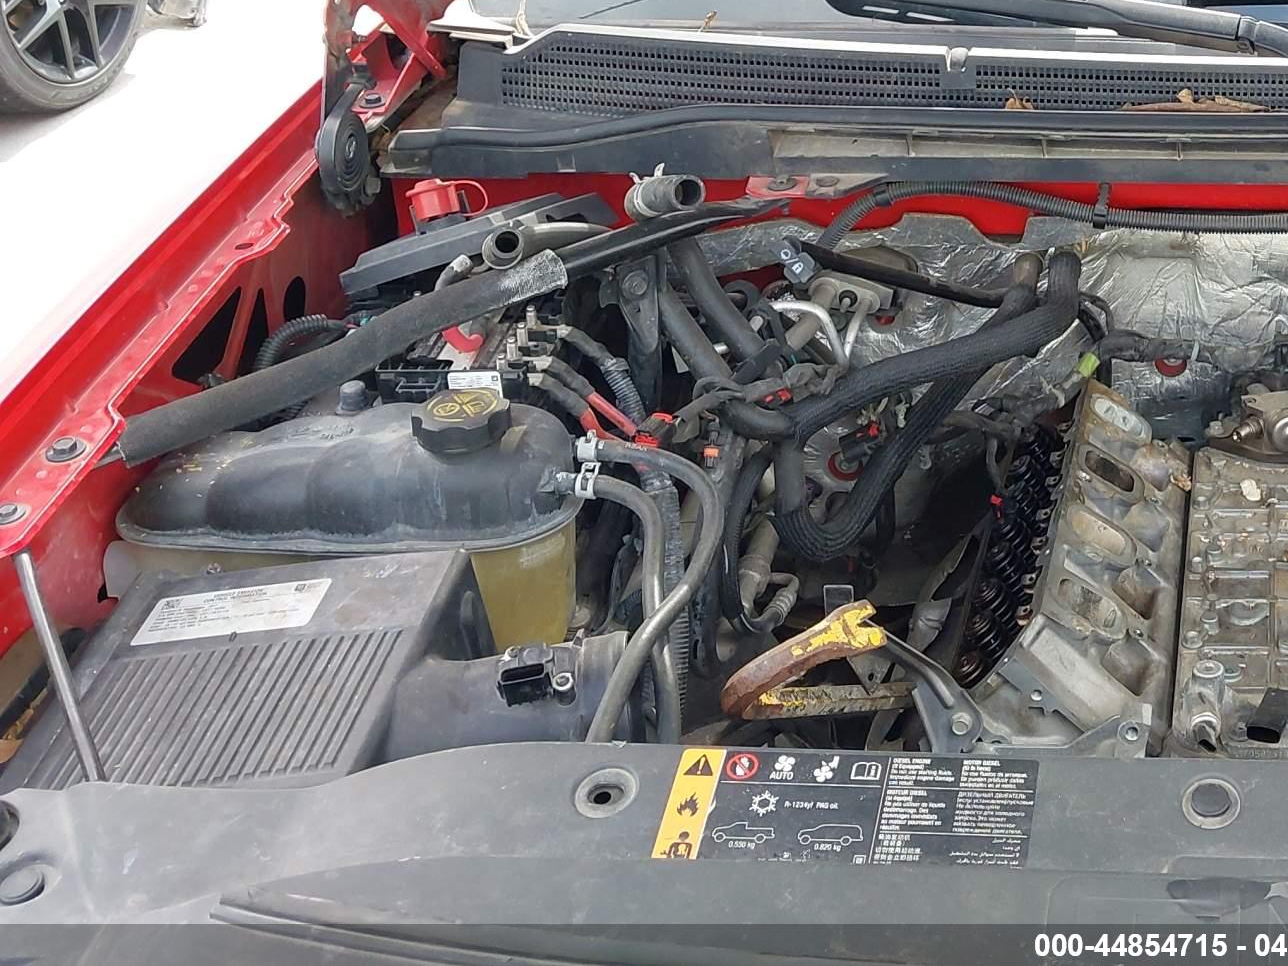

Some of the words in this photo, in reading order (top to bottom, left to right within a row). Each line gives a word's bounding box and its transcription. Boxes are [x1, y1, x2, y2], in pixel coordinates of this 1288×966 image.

[769, 771, 794, 780] AUTO
[747, 841, 756, 850] kg
[833, 844, 841, 852] kg
